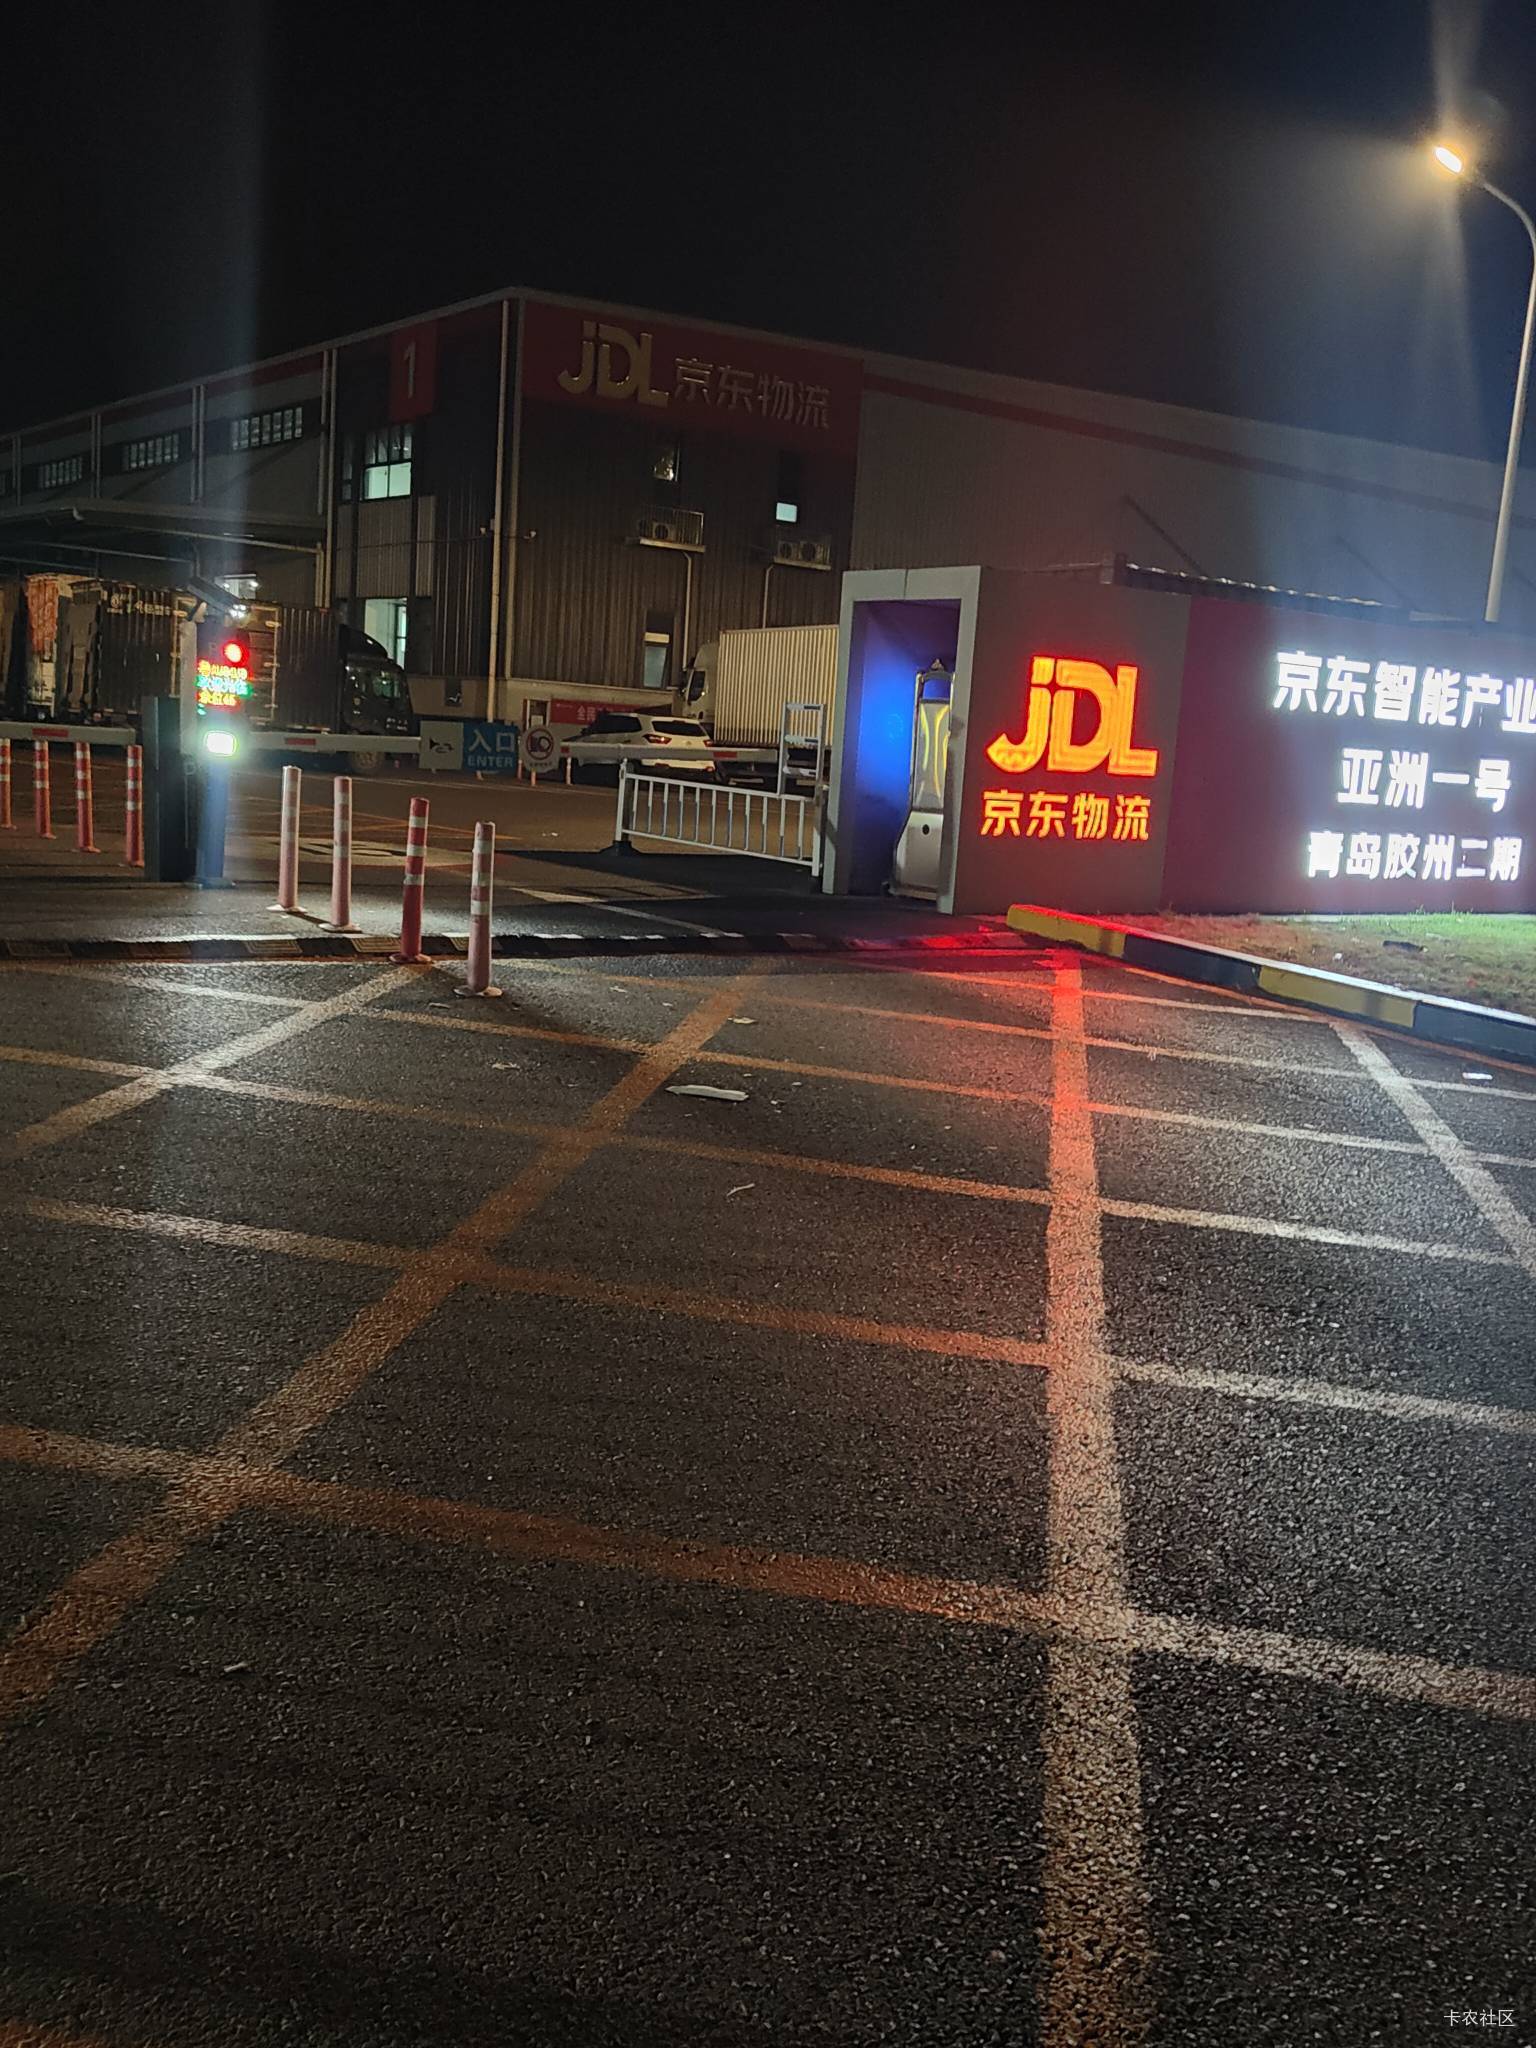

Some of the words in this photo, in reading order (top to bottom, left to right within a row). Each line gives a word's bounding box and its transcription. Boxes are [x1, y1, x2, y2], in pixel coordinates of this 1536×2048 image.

[403, 341, 416, 399] 1
[558, 320, 669, 408] JDL
[674, 358, 830, 429] 京东物流
[986, 656, 1158, 777] JDL
[1273, 650, 1536, 734] 京东智能产业
[467, 755, 513, 768] ENTER
[468, 729, 516, 753] 入口
[1337, 748, 1511, 813] 亚洲一号
[980, 789, 1151, 841] 京东物流
[1307, 830, 1523, 881] 青岛胶州二期
